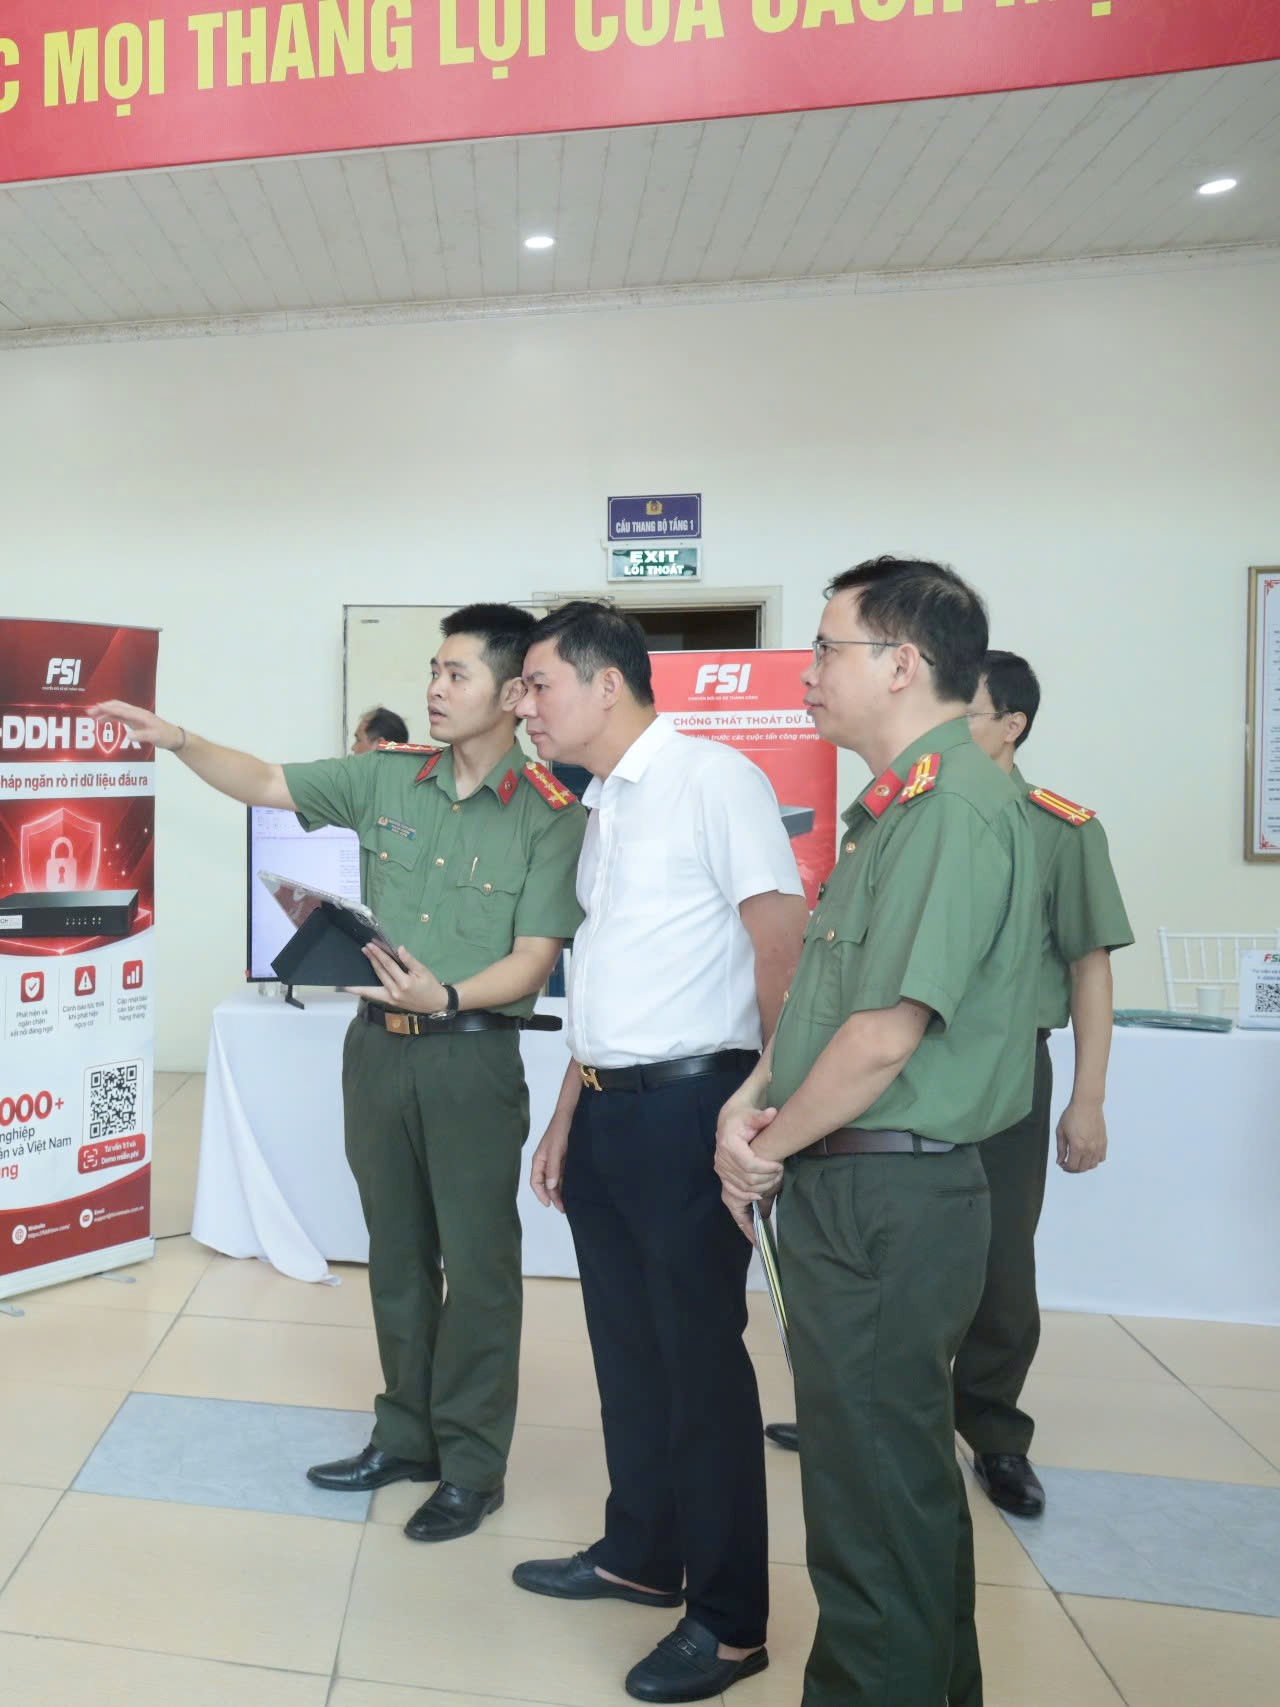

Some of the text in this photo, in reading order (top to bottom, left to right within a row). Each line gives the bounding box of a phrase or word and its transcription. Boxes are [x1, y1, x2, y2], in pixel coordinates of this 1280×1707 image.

[43, 19, 165, 118] MỌI
[632, 520, 656, 533] THANG
[657, 518, 668, 534] BỘ
[690, 519, 694, 531] 1
[629, 550, 679, 563] EXIT
[623, 561, 685, 576] LỐI THOÁT
[46, 657, 82, 686] FSI
[695, 663, 752, 695] FSI
[673, 713, 712, 727] CHỐNG
[715, 712, 743, 726] THẤT
[746, 711, 783, 725] THOÁT
[25, 773, 54, 792] ngăn
[96, 773, 116, 790] liệu
[139, 774, 149, 787] ra
[0, 1125, 36, 1146] nghiệp
[12, 1144, 25, 1157] và
[26, 1139, 47, 1155] Việt
[48, 1136, 72, 1150] Nam
